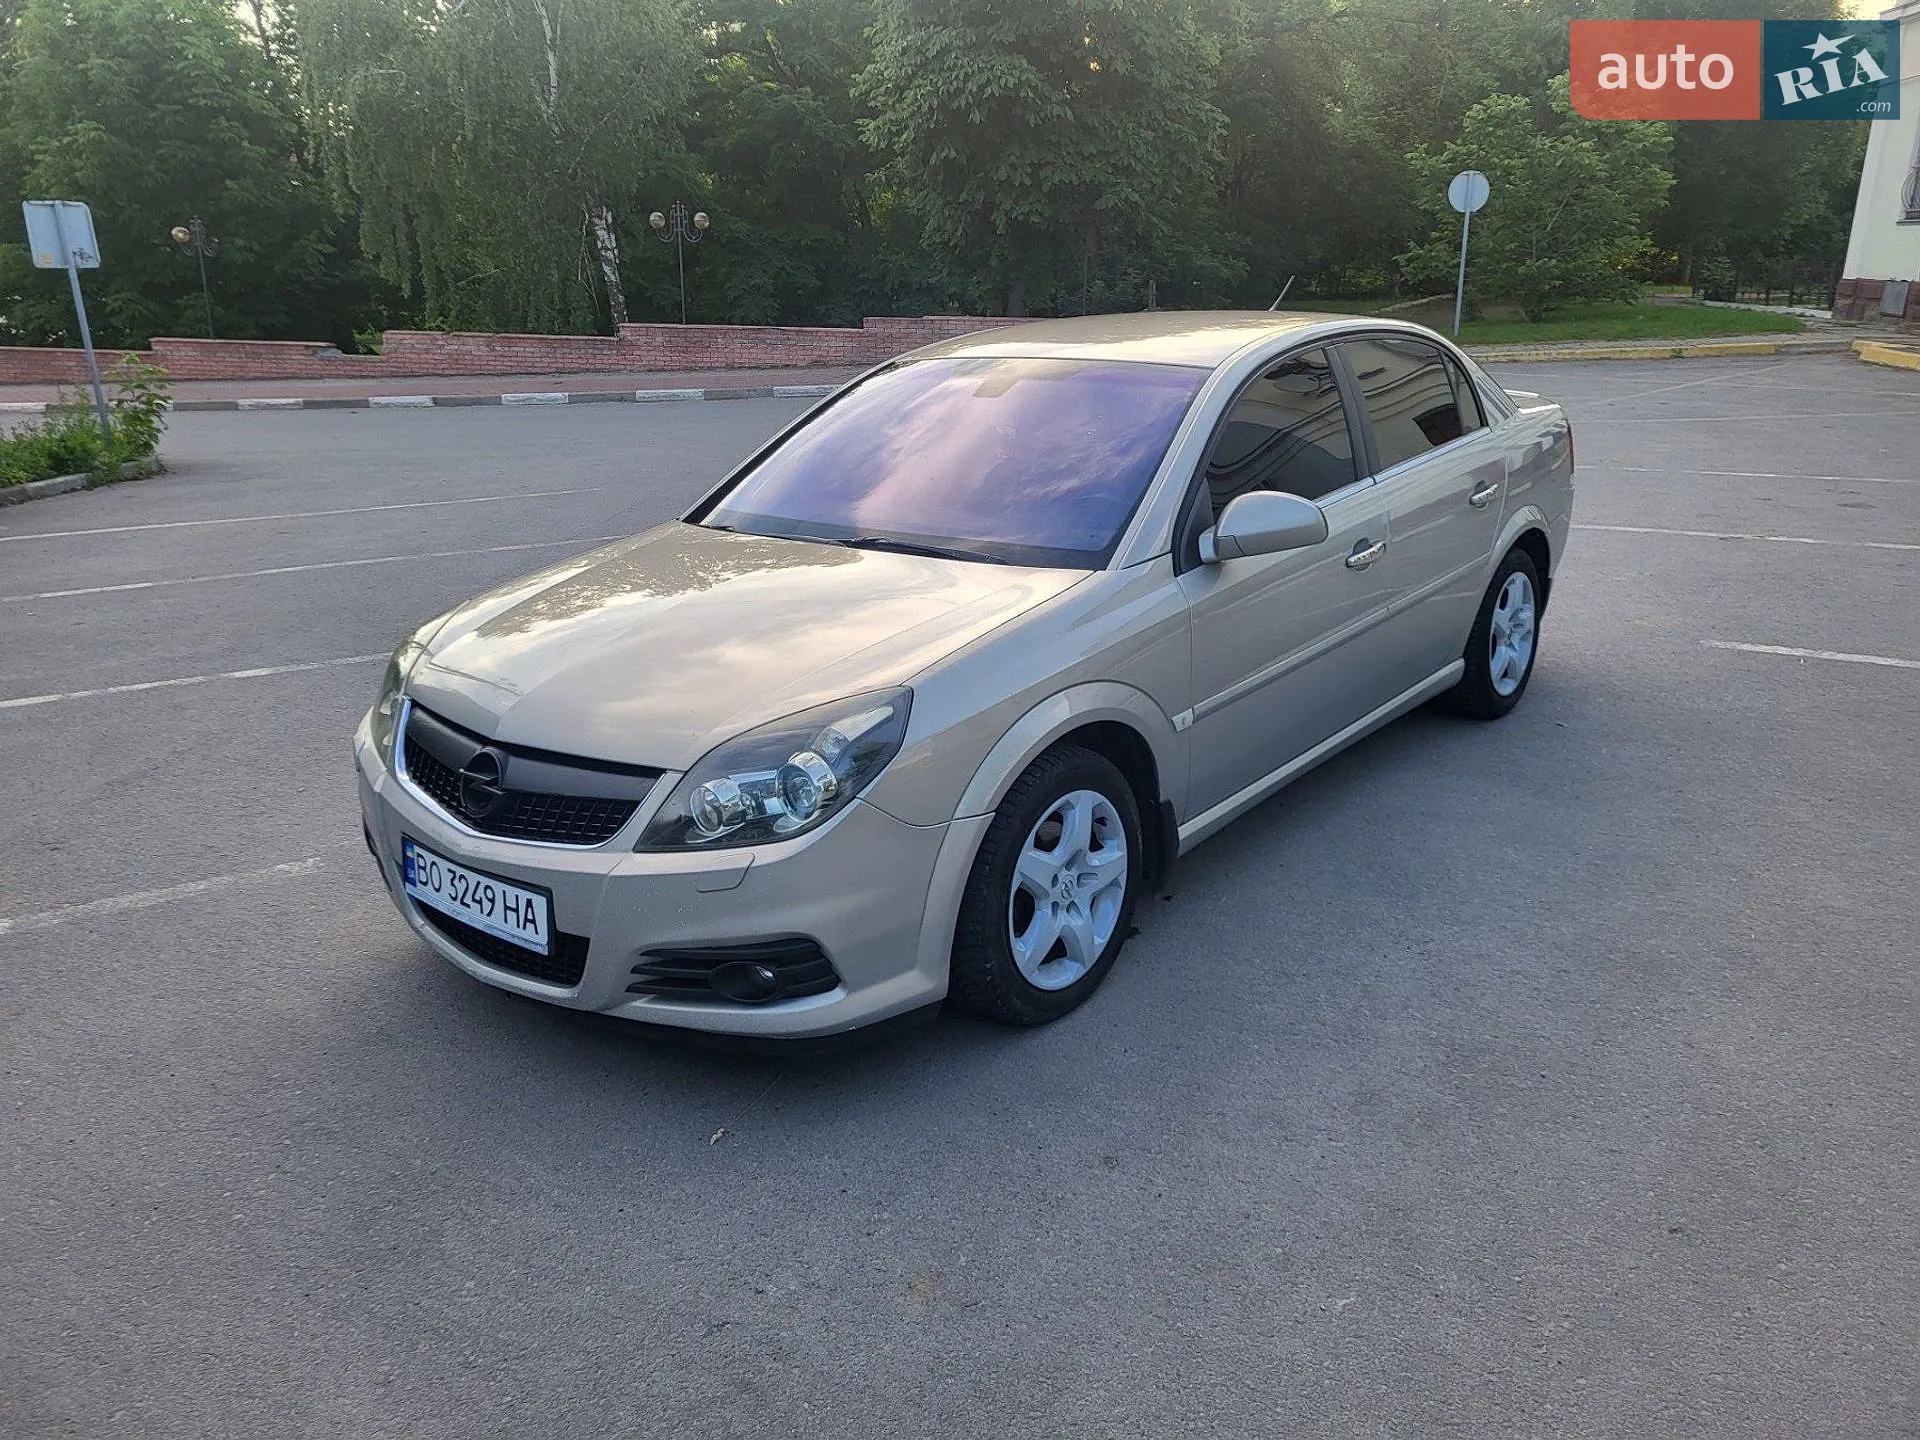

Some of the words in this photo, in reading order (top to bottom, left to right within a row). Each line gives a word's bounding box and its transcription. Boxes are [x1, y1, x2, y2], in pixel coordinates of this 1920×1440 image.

[416, 853, 442, 893] BO
[447, 868, 496, 917] 3249
[502, 889, 539, 935] HA
